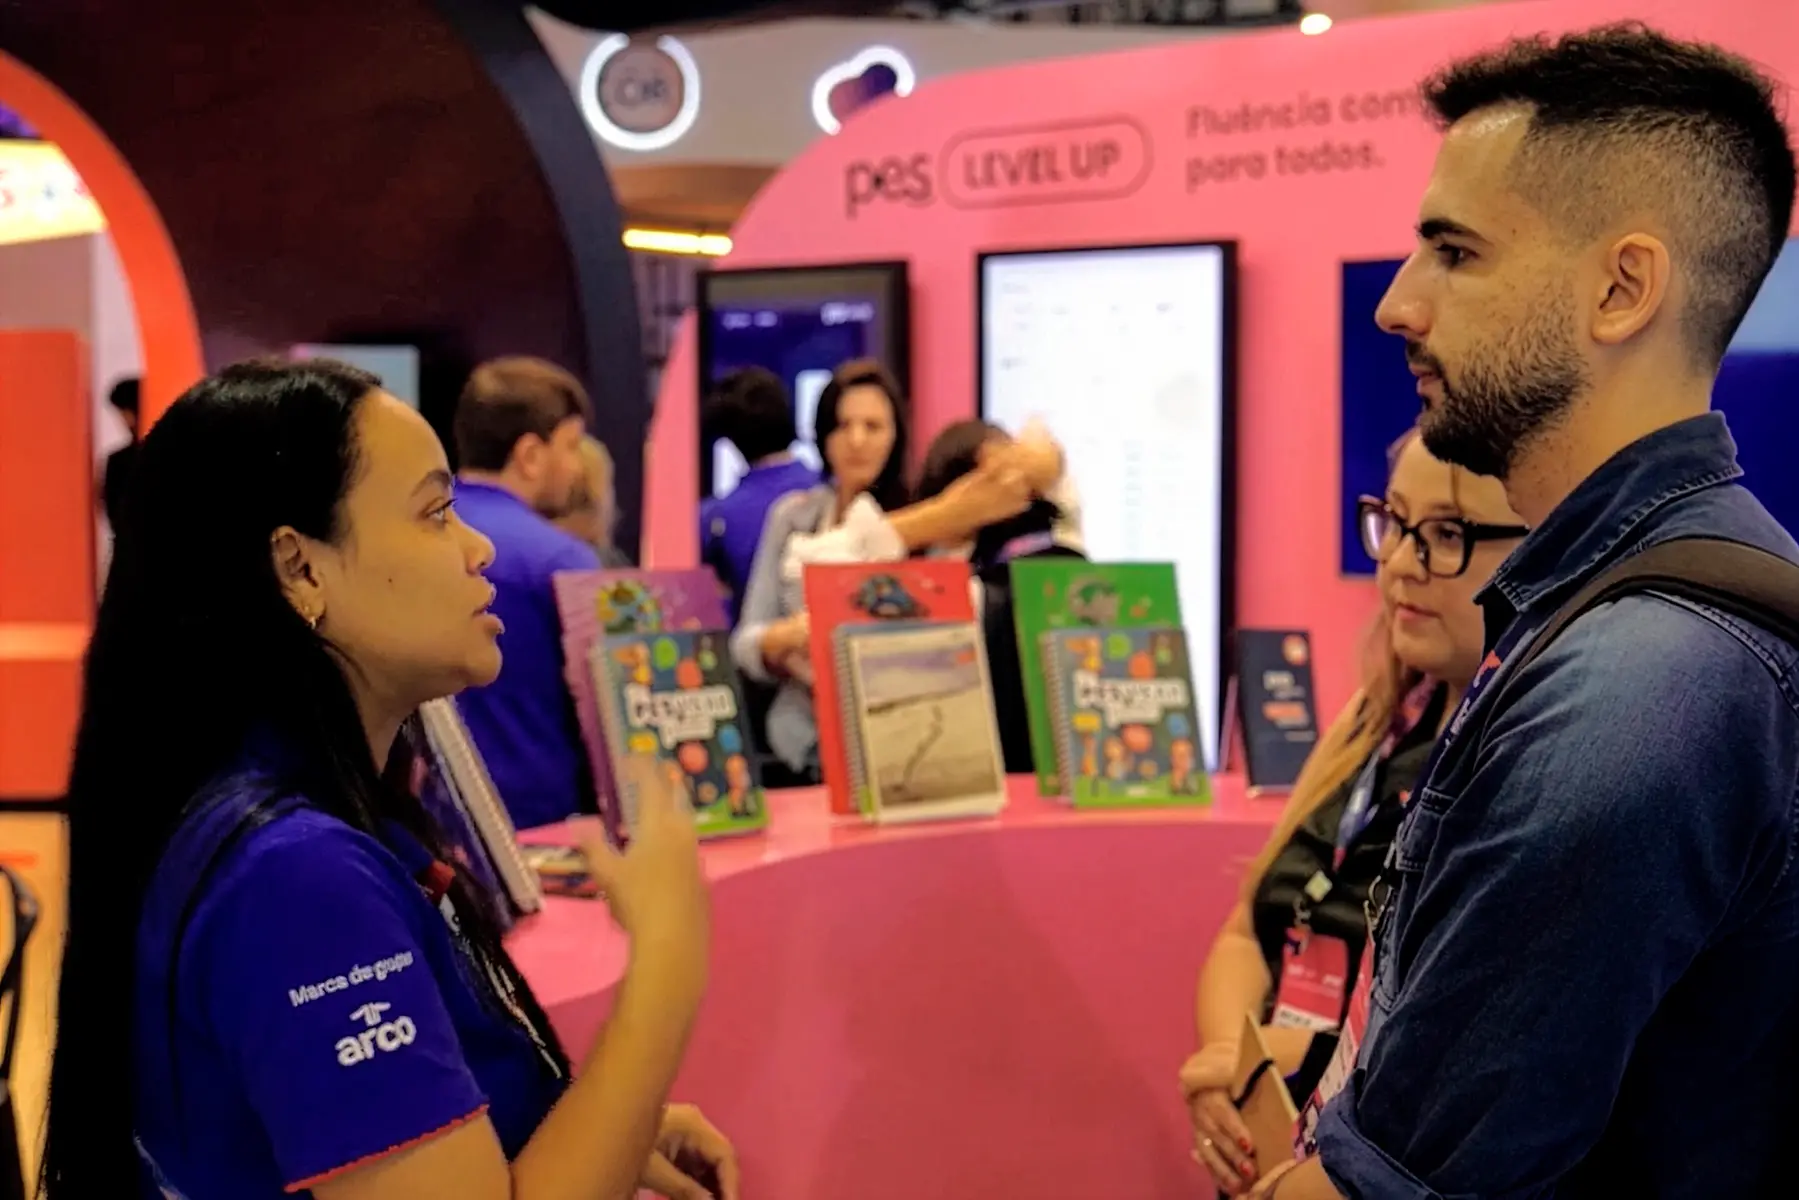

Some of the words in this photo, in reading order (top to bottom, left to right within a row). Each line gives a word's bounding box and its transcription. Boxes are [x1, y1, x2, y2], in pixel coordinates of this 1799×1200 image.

[845, 151, 933, 219] pes
[963, 145, 1063, 189] LEVEL
[1068, 140, 1121, 180] UP
[1186, 150, 1268, 194] para
[1275, 139, 1386, 175] todos.
[288, 974, 349, 1007] Marca
[334, 1015, 417, 1066] arco
